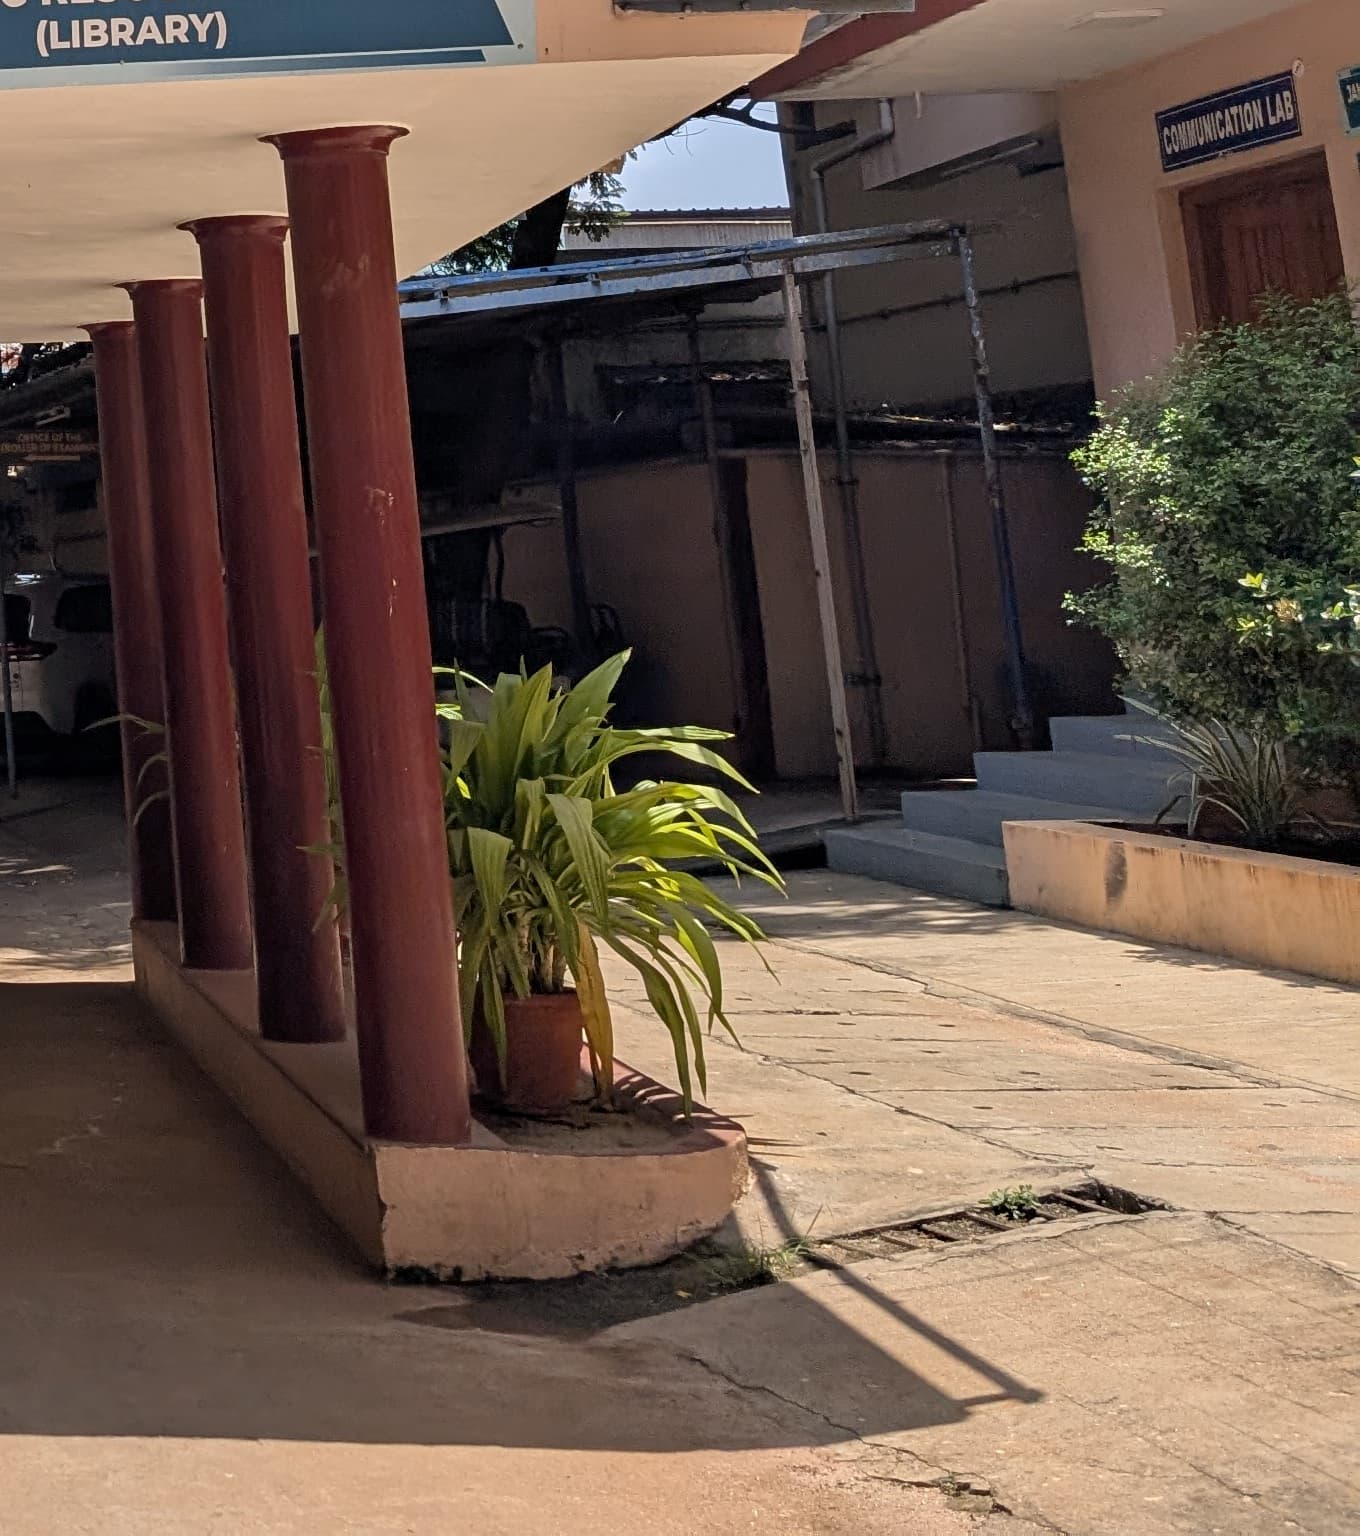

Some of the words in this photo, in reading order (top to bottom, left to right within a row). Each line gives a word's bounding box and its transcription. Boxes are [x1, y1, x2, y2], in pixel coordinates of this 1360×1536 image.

[36, 12, 228, 58] (LIBRARY)
[1163, 98, 1264, 155] COMMUNICATION
[1266, 90, 1295, 125] LAB
